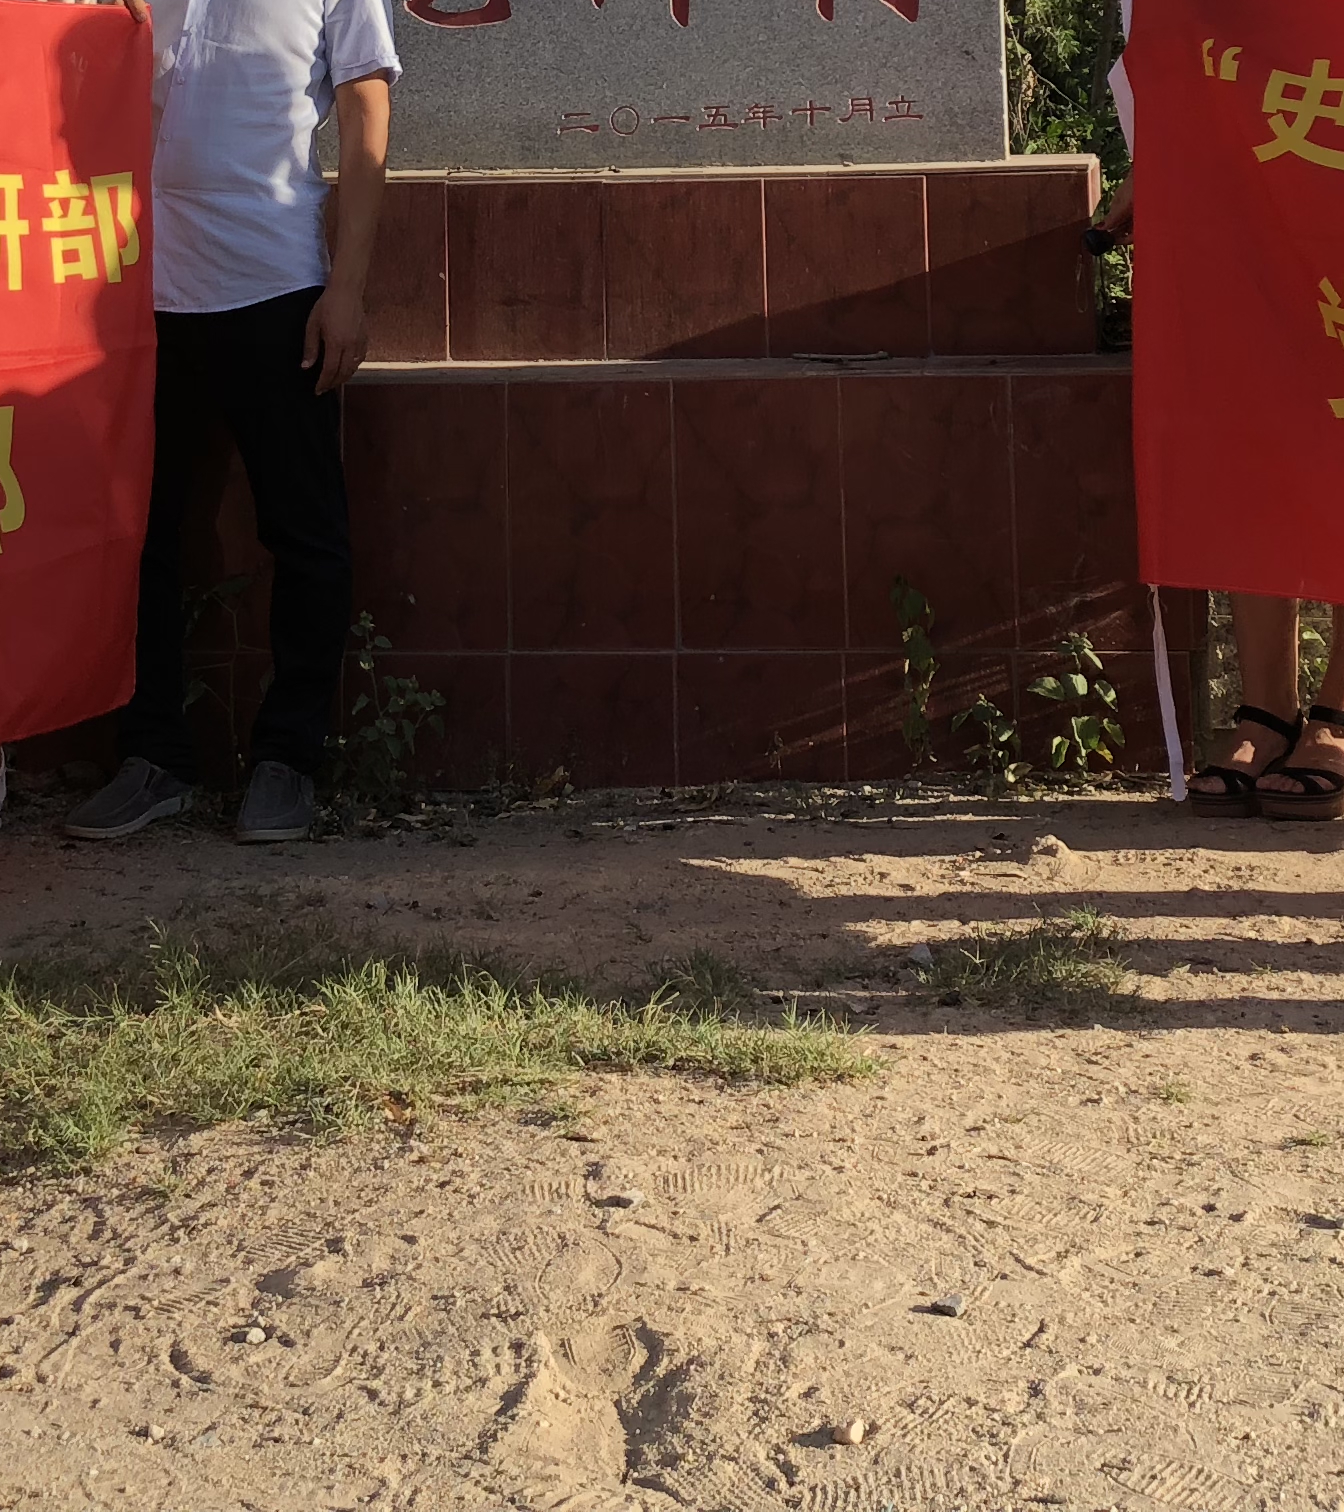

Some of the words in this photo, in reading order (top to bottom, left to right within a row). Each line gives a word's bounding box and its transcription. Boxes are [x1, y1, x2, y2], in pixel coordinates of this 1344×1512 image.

[557, 95, 924, 137] 二〇一五年十月立
